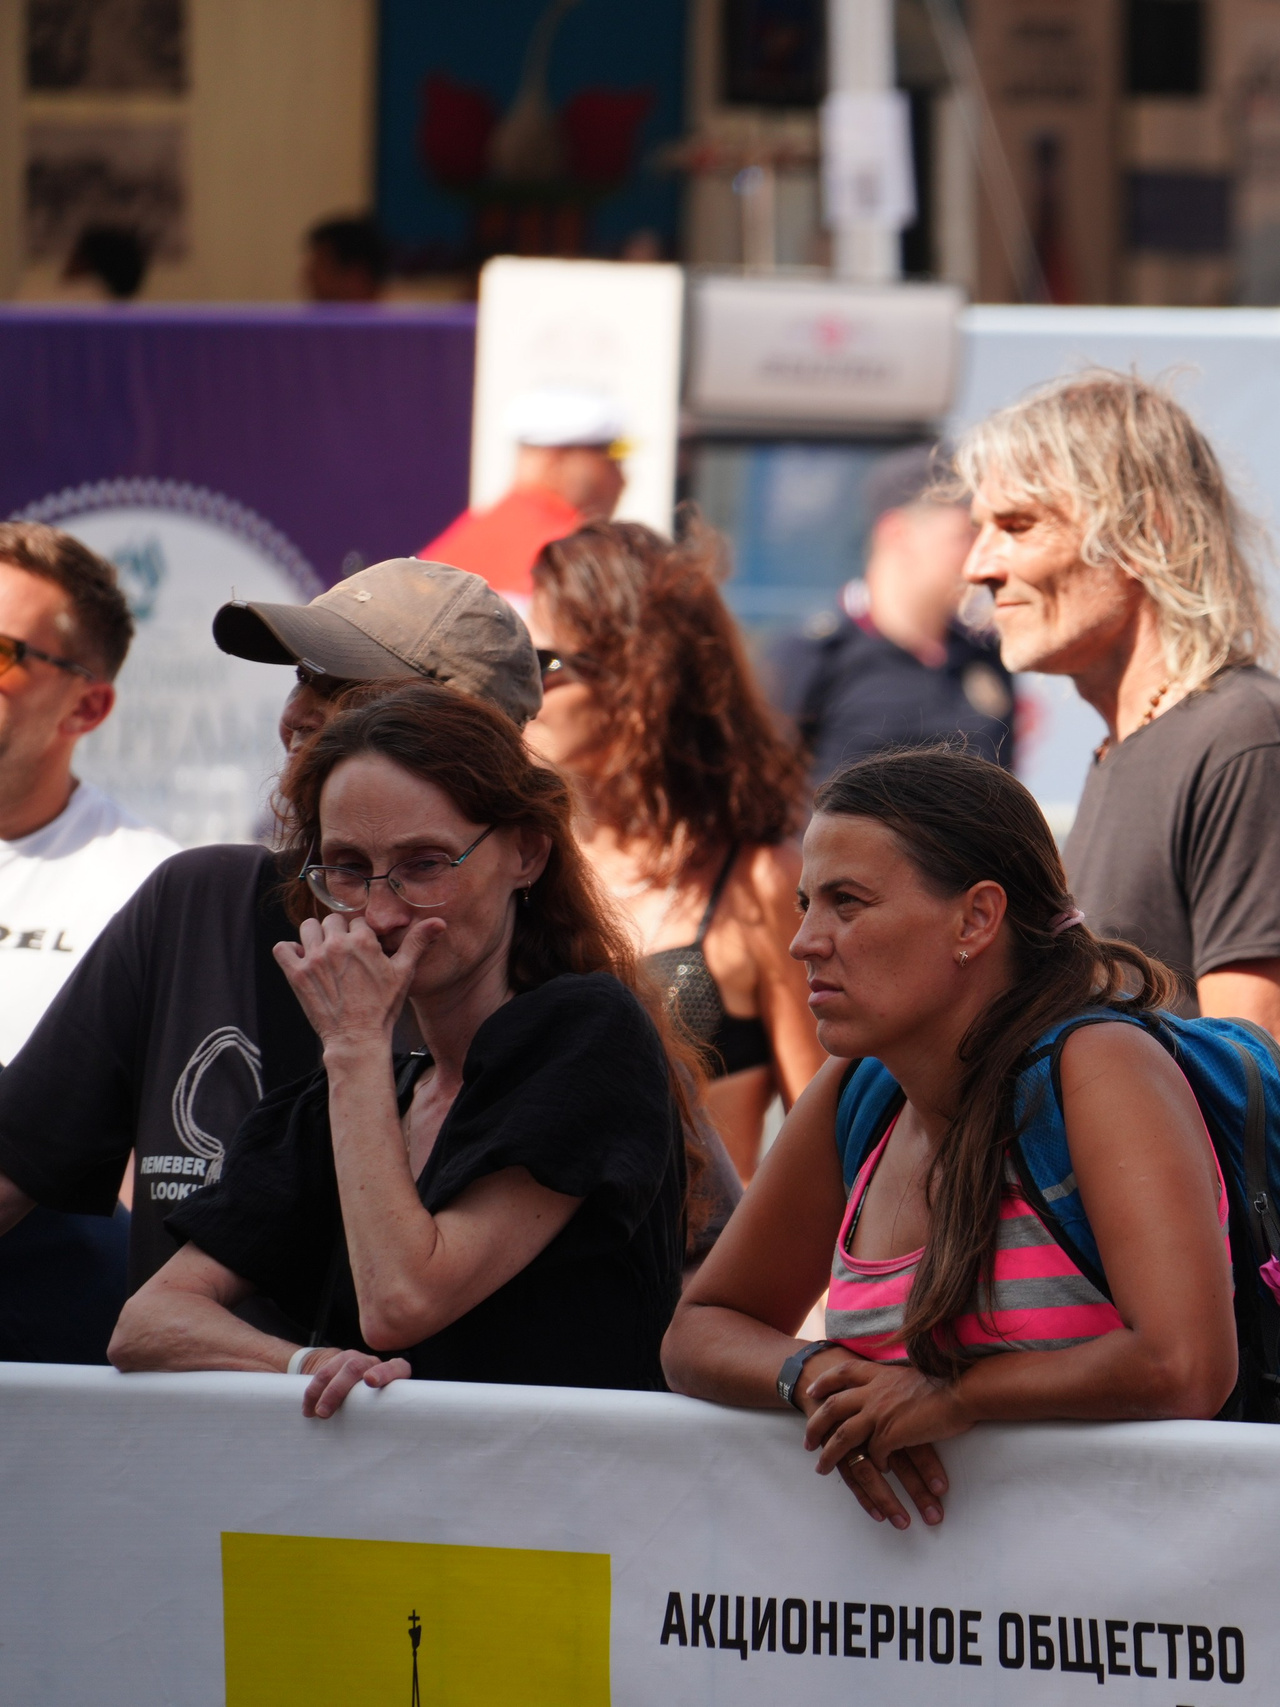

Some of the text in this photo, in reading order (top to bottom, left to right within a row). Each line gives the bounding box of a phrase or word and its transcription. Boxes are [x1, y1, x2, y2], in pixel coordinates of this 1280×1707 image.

[141, 1156, 206, 1176] REMEBER
[151, 1182, 203, 1200] LOOK
[660, 1591, 1245, 1684] АКЦИОНЕРНОЕ ОБЩЕСТВО
